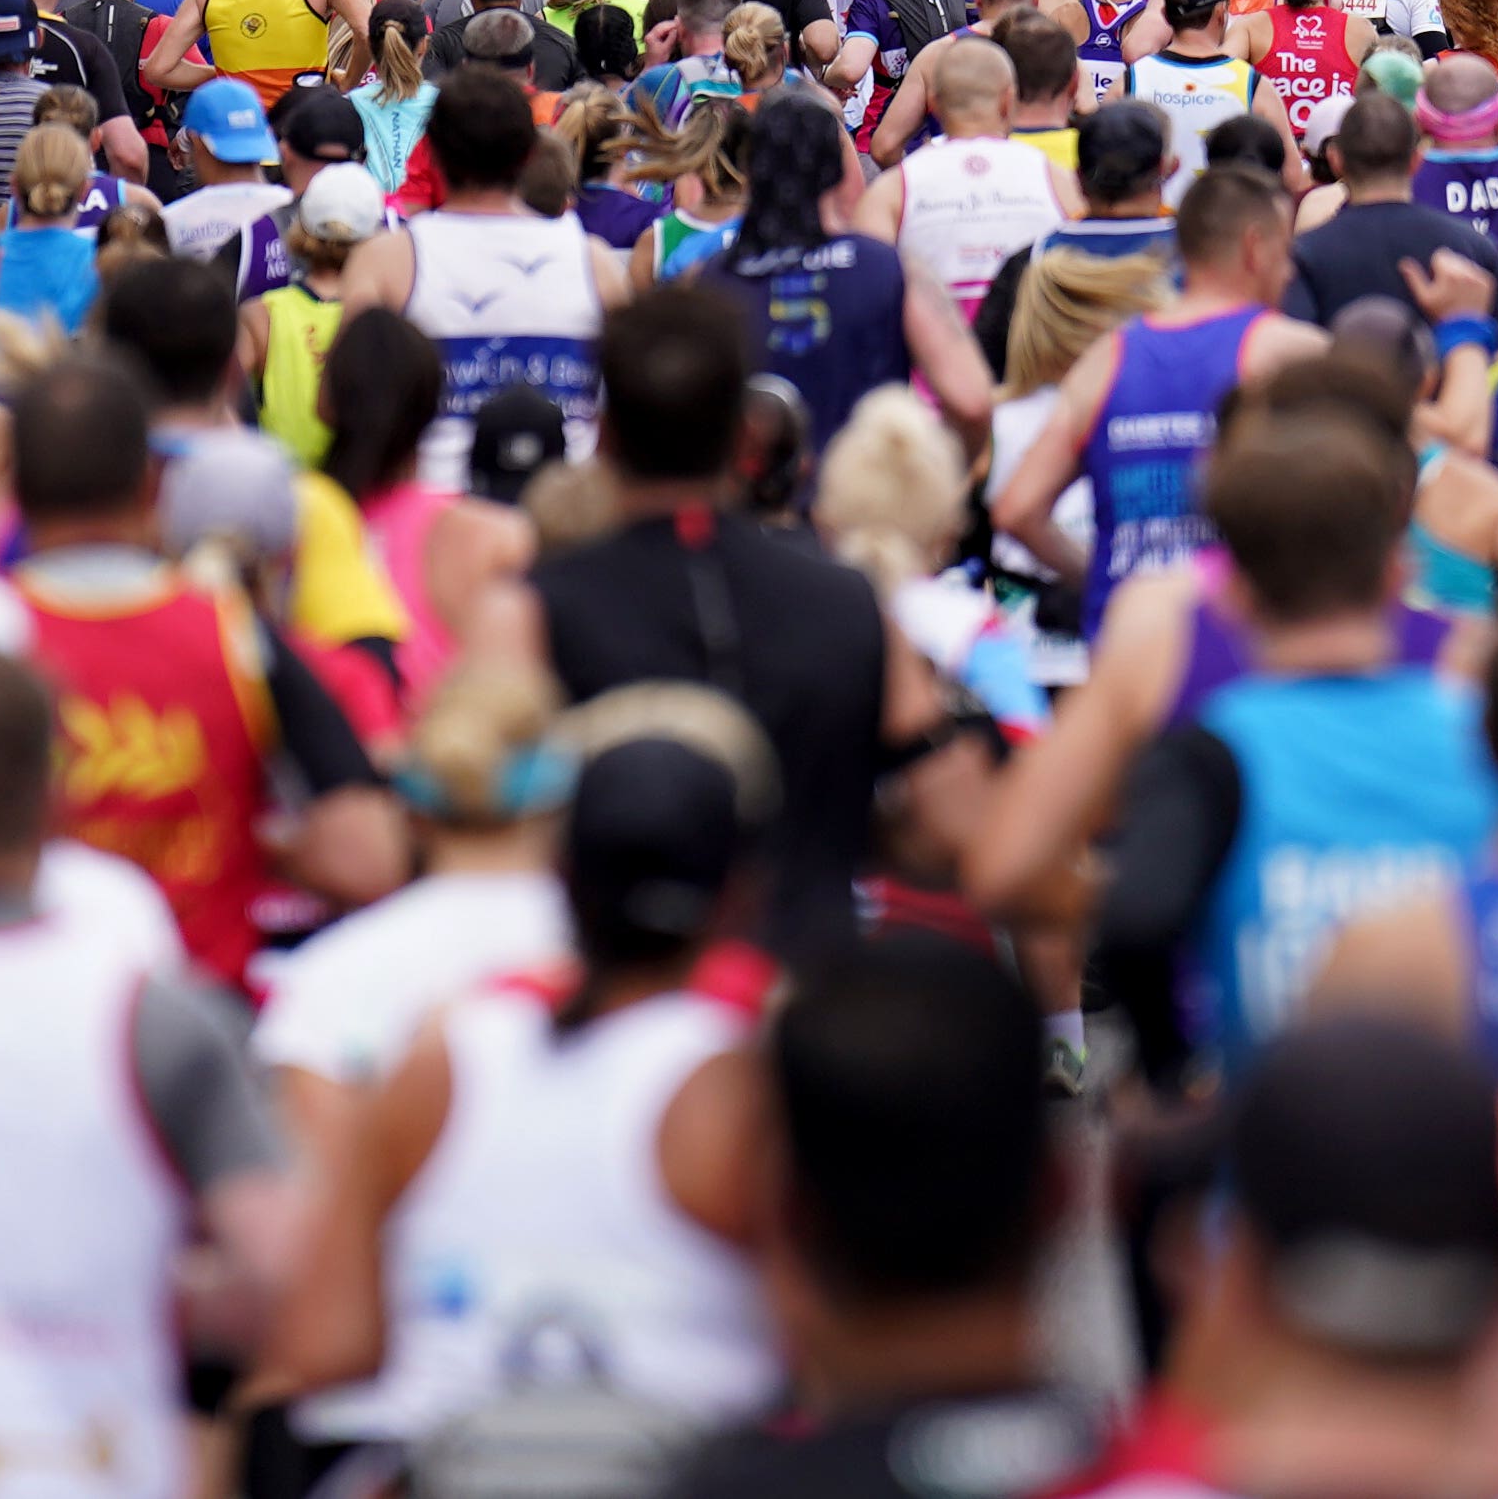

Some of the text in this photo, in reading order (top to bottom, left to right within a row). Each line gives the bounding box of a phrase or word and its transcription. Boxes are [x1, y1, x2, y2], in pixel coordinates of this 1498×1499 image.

[1276, 52, 1316, 73] The
[1153, 89, 1214, 106] hospice
[1331, 73, 1352, 99] is
[391, 111, 401, 169] NATHAN
